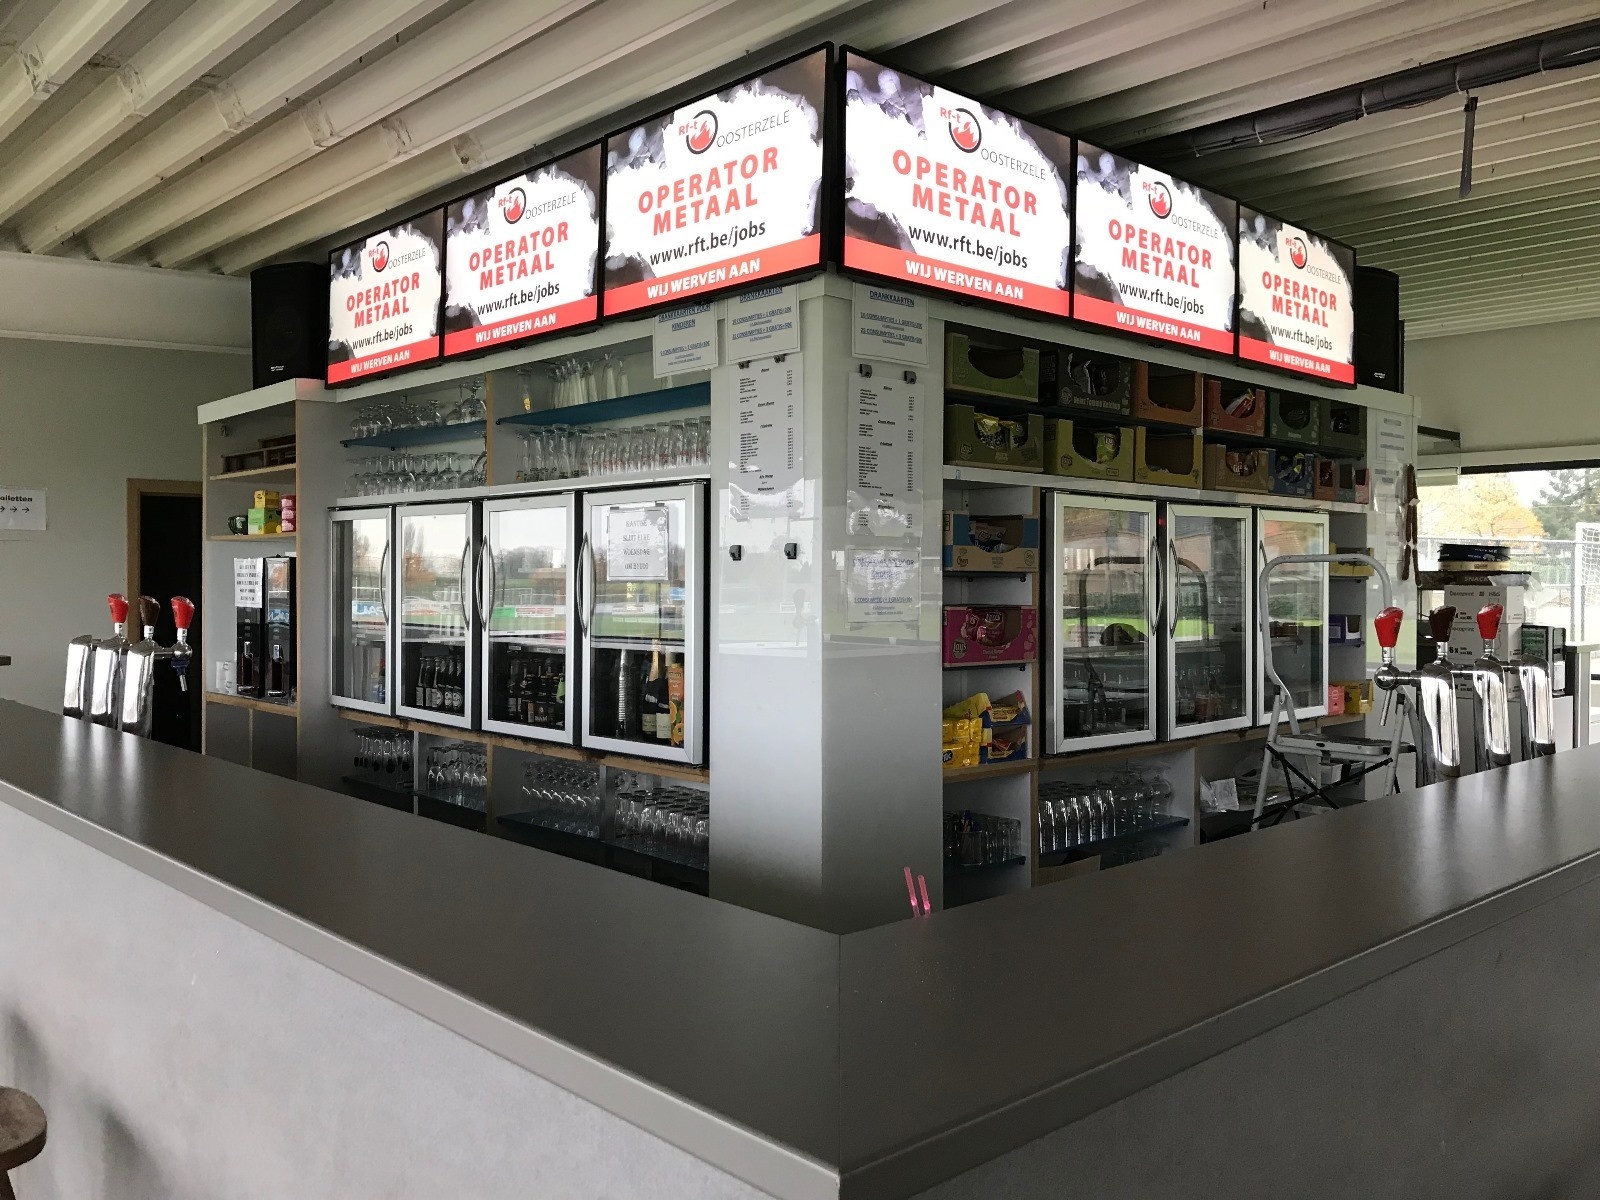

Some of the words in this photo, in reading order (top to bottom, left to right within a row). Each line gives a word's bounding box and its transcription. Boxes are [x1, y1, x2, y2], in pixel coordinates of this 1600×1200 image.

[716, 110, 790, 148] OOSTERZELE
[638, 146, 778, 213] OPERATOR
[981, 148, 1046, 180] OOSTERZELE
[893, 150, 1037, 215] OPERATOR
[525, 192, 577, 220] OOSTERZELE
[653, 183, 758, 235] METAAL
[913, 184, 1021, 237] METAAL
[650, 220, 766, 265] www.rft.be/jobs
[1172, 214, 1219, 239] OOSTERZELE
[388, 247, 426, 270] OOSTERZELE
[469, 222, 569, 272] OPERATOR
[909, 226, 1028, 268] www.rft.be/jobs
[1109, 219, 1212, 269] OPERATOR
[480, 251, 554, 290] METAAL
[647, 282, 668, 299] WIJ
[671, 268, 726, 292] WERVEN
[729, 258, 760, 279] AAN
[906, 260, 931, 278] WIJ
[934, 268, 992, 291] WERVEN
[995, 282, 1024, 300] AAN
[1122, 248, 1199, 289] METAAL
[1307, 265, 1342, 284] OOSTERZELE
[347, 272, 420, 311] OPERATOR
[477, 282, 560, 315] www.rft.be/jobs
[870, 291, 914, 307] DRANKKAARTEN
[1119, 281, 1204, 315] www.rft.be/jobs
[1262, 271, 1337, 311] OPERATOR
[354, 300, 410, 328] METAAL
[476, 327, 491, 343] WIJ
[492, 318, 533, 339] WERVEN
[534, 313, 556, 331] AAN
[1117, 311, 1135, 326] WIJ
[1137, 318, 1178, 336] WERVEN
[1181, 328, 1201, 341] AAN
[1272, 295, 1329, 328] METAAL
[352, 322, 413, 349] www.rft.be/jobs
[1271, 325, 1333, 350] www.rft.be/jobs
[351, 362, 362, 374] WIJ
[363, 355, 393, 370] WERVEN
[394, 350, 410, 362] AAN
[1269, 350, 1282, 361] WIJ
[1283, 353, 1314, 370] WERVEN
[1315, 361, 1331, 374] AAN
